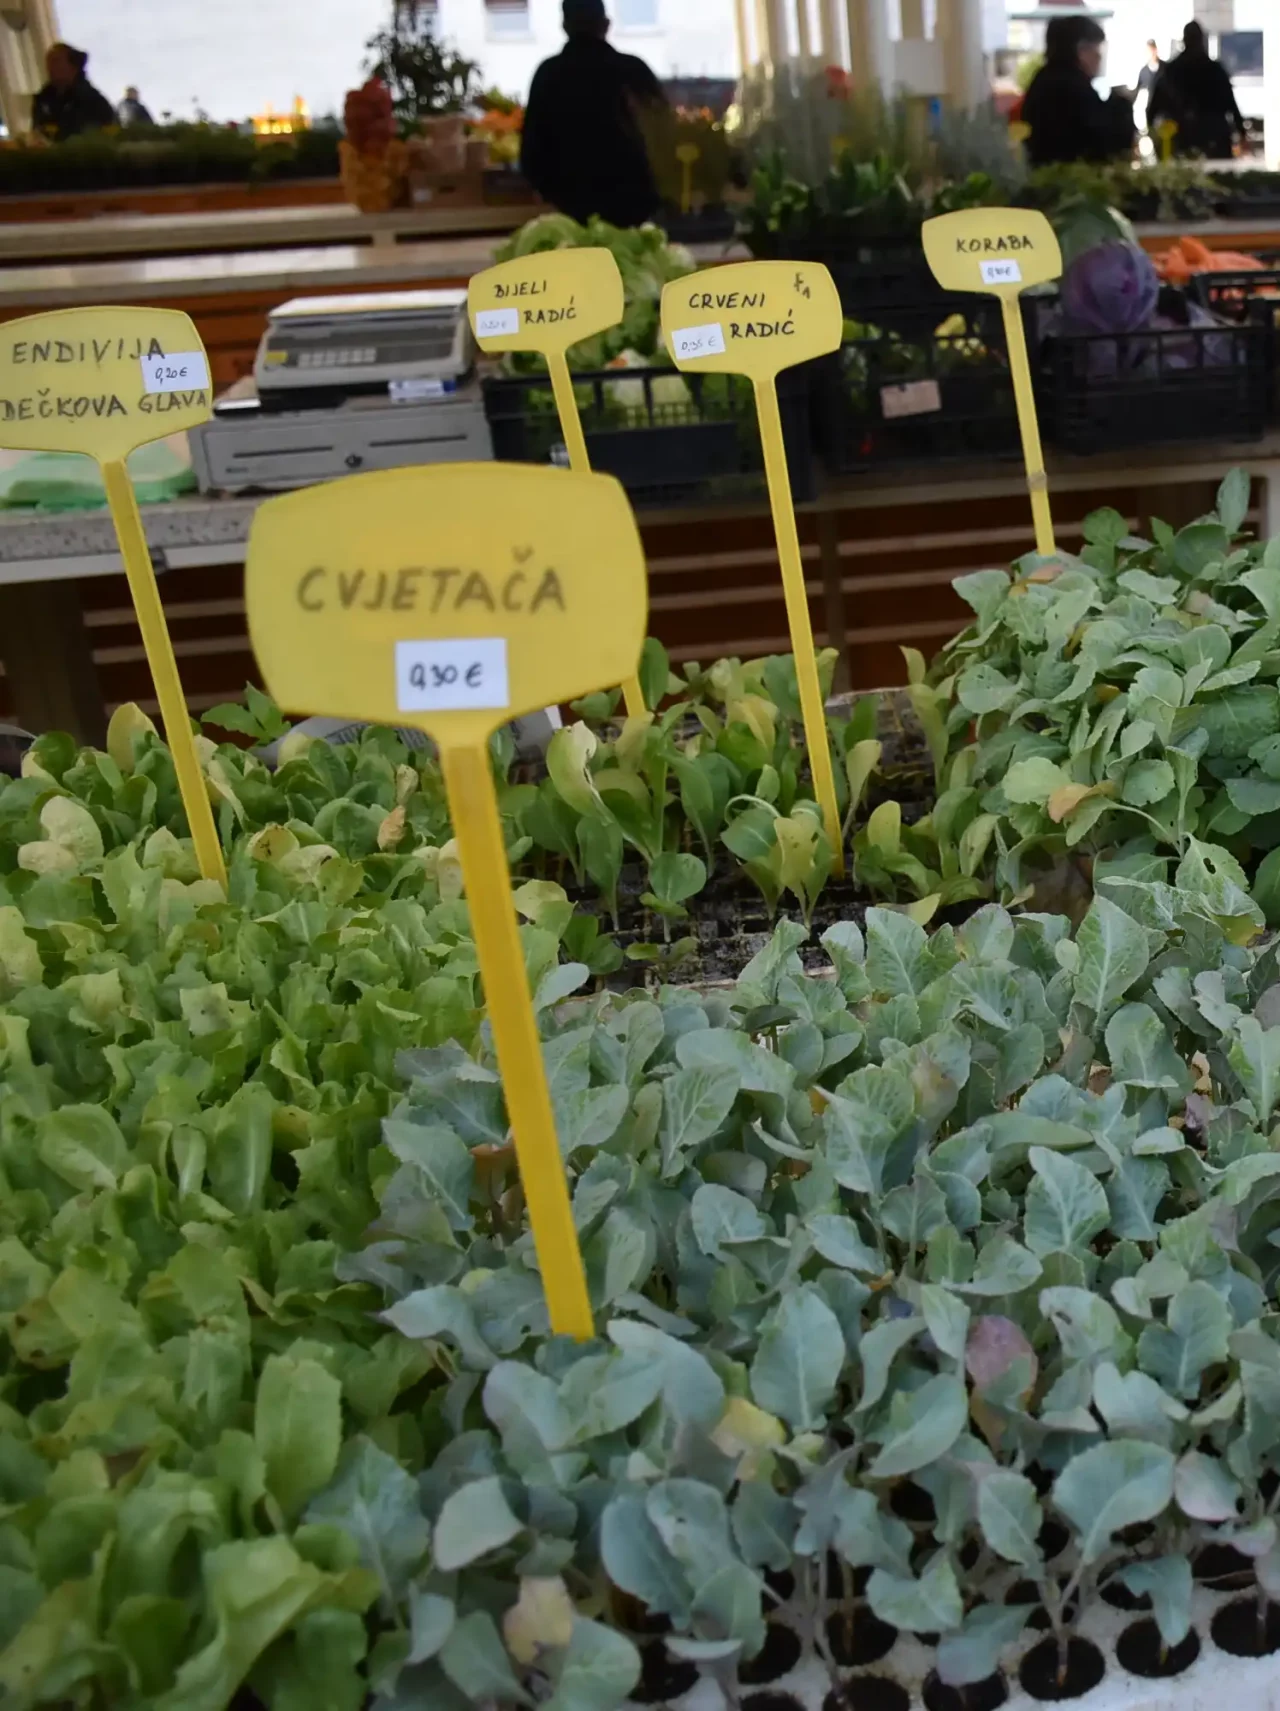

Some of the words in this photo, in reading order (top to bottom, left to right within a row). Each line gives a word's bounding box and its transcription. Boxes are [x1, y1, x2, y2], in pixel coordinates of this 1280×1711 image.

[956, 234, 1034, 253] KORABA
[494, 280, 547, 298] BIJELI
[689, 292, 766, 310] CRVENI
[523, 295, 577, 324] RADIĆ
[730, 308, 796, 339] RADIĆ
[12, 337, 166, 365] ENDIVIJA
[137, 389, 207, 415] GLAVA
[296, 543, 567, 615] CVJETAČA
